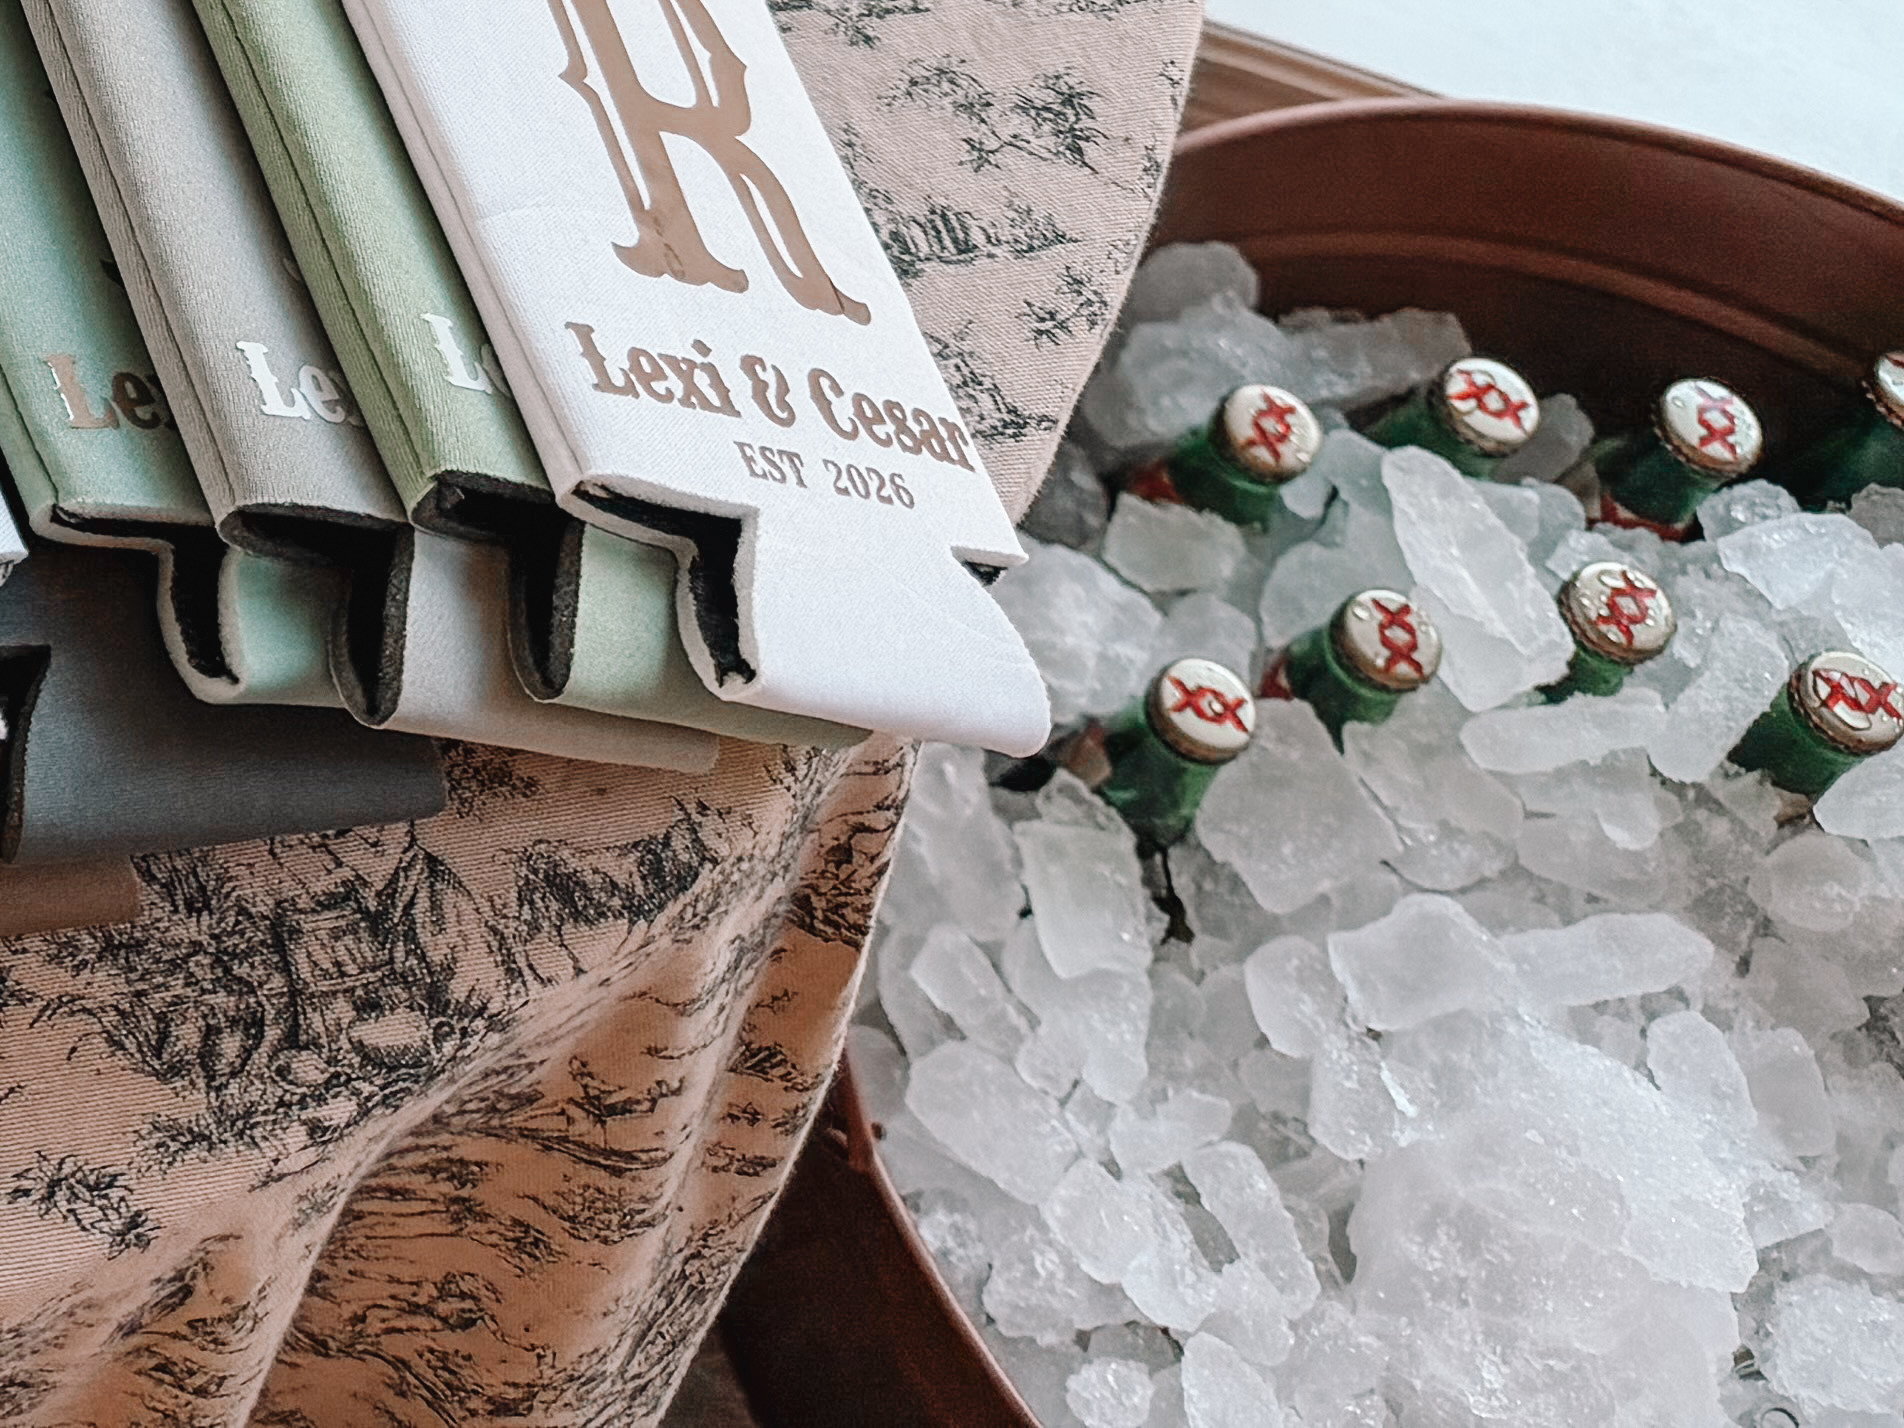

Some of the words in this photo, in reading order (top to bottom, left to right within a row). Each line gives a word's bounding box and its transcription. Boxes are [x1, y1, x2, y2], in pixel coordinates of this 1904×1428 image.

[41, 354, 175, 430] Le
[236, 340, 363, 428] Le
[565, 322, 741, 418] Lexi
[739, 354, 796, 429] &
[806, 368, 975, 475] Cesar
[733, 440, 808, 489] EST
[821, 457, 915, 510] 2026
